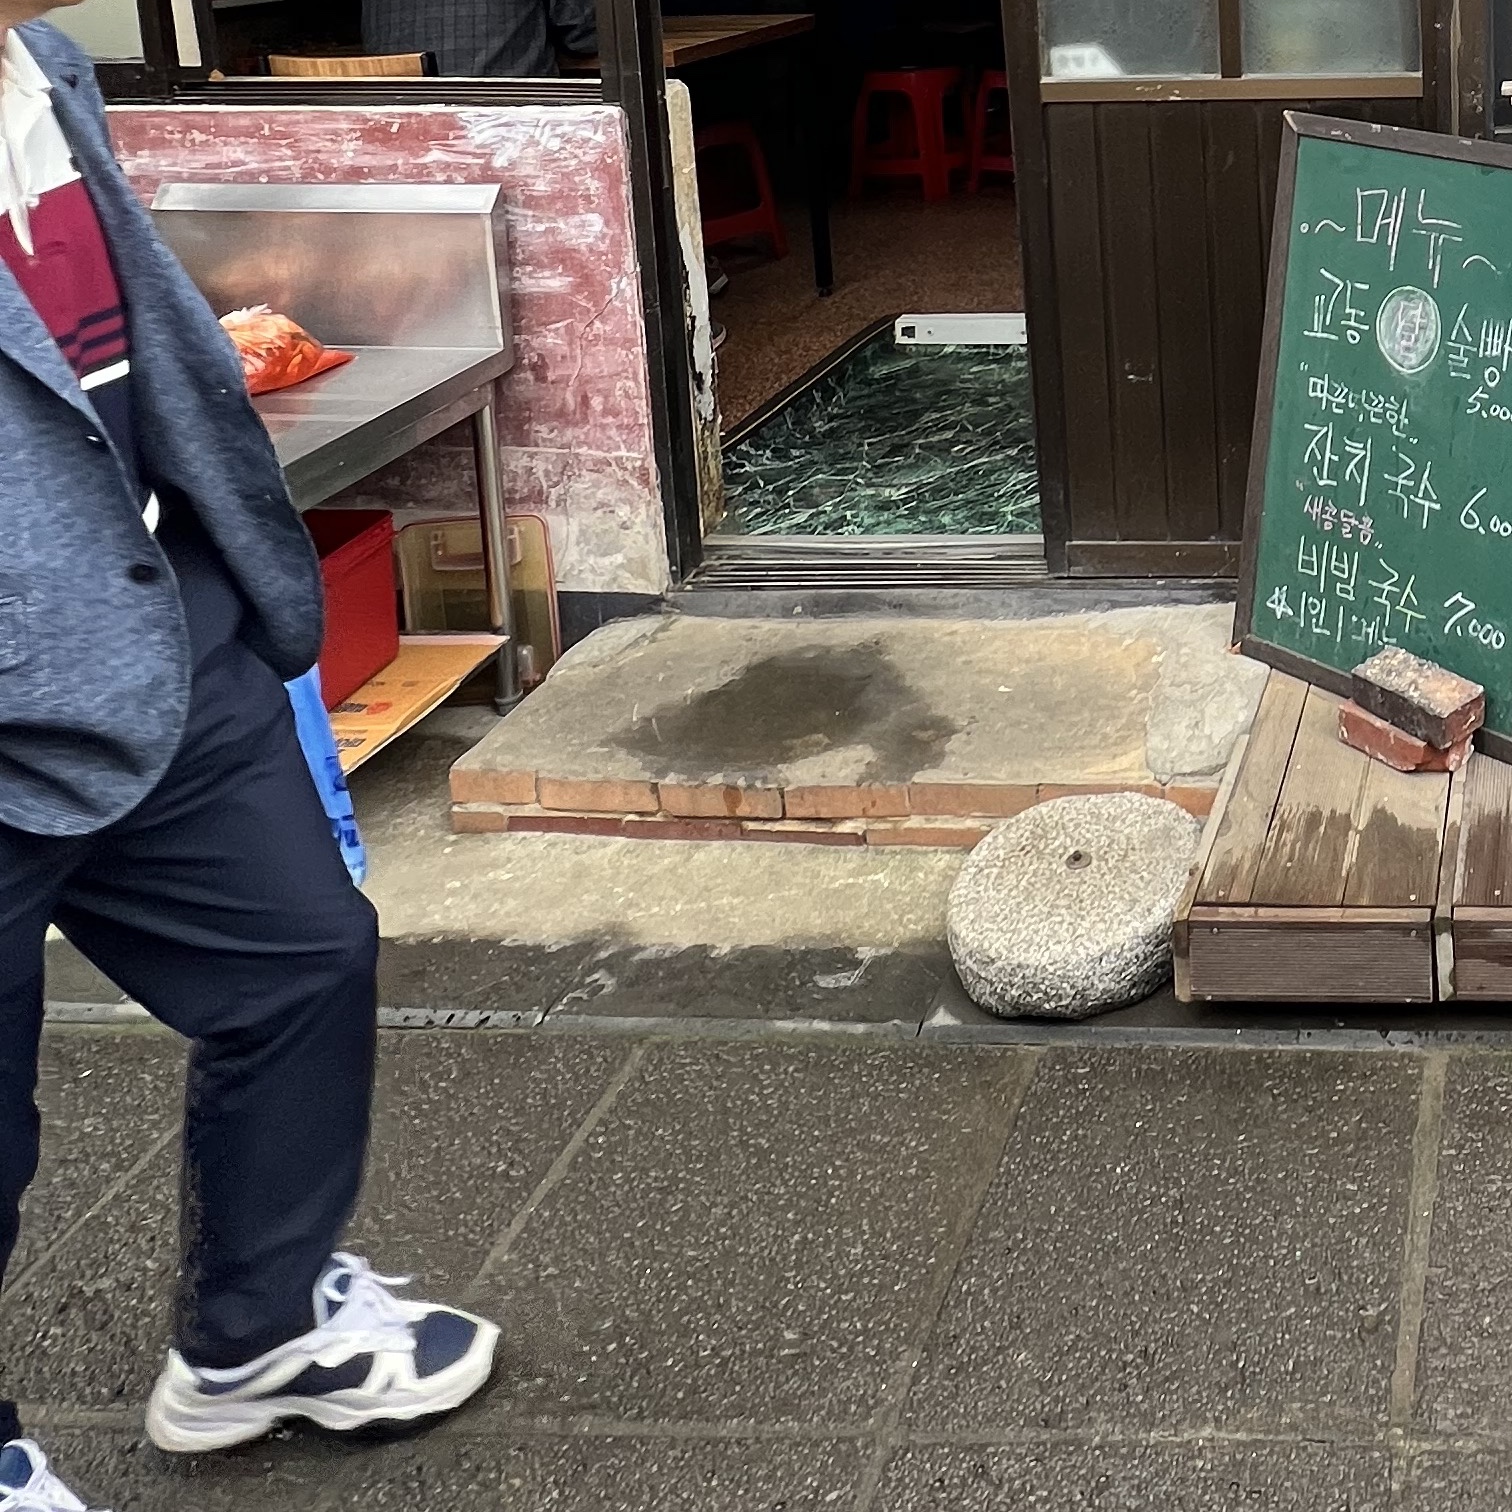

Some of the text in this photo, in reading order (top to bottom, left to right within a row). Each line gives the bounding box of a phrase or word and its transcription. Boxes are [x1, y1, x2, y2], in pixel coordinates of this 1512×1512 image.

[1356, 187, 1463, 289] 메뉴
[1302, 267, 1371, 345] 교동
[1303, 421, 1373, 507] 잔치
[1383, 444, 1442, 530] 국수
[1297, 535, 1360, 601] 비빔
[1367, 557, 1427, 634] 국수
